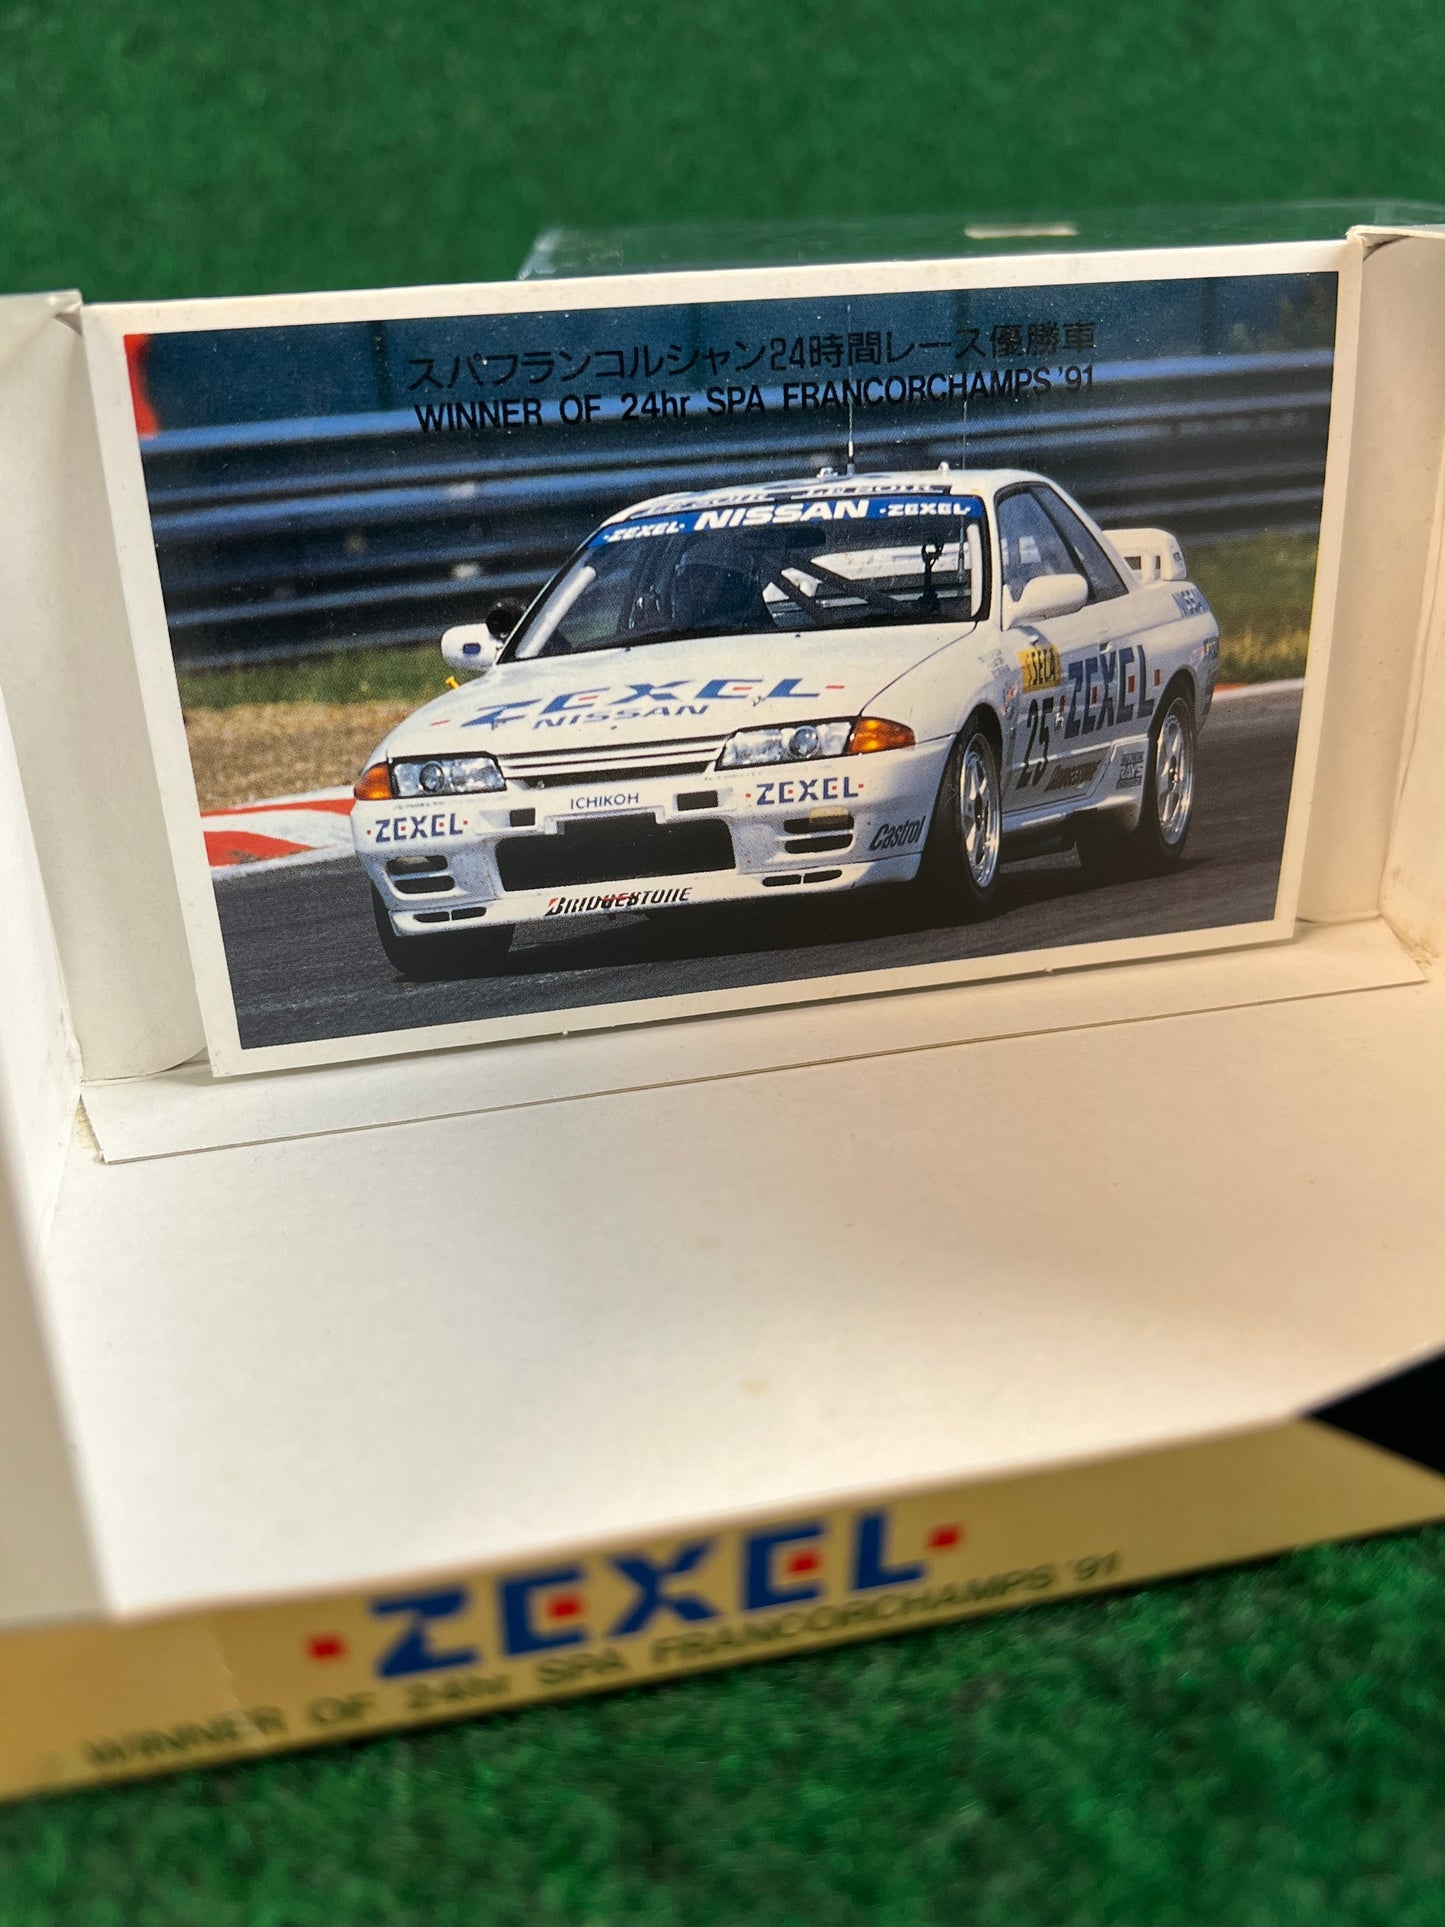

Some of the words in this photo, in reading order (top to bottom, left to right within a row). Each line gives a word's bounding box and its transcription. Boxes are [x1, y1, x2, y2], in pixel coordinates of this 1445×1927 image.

[408, 320, 1097, 390] スパフランコルシャン24時間レース優勝車
[414, 398, 543, 433] WINNER
[560, 394, 601, 425] OF
[621, 391, 691, 421] 24hr
[707, 385, 765, 417] SPA
[783, 366, 1051, 410] FRANCORCHAMPS
[695, 500, 869, 530] NISSAN
[462, 678, 821, 728] ZEXEL
[533, 704, 709, 729] NISSAN
[1064, 645, 1155, 739] ZEXEL
[1016, 697, 1054, 790] 25
[570, 792, 639, 811] ICHIKOH
[757, 776, 859, 806] ZEXEL
[375, 813, 464, 843] ZEXEL
[869, 816, 927, 851] Castrol
[369, 1506, 931, 1680] ZEXEL
[85, 1703, 288, 1768] WINNER
[307, 1689, 376, 1729] OF
[406, 1671, 514, 1711] 24hr
[535, 1646, 628, 1688] SPA
[652, 1567, 1055, 1663] FRANCORCHAMPS
